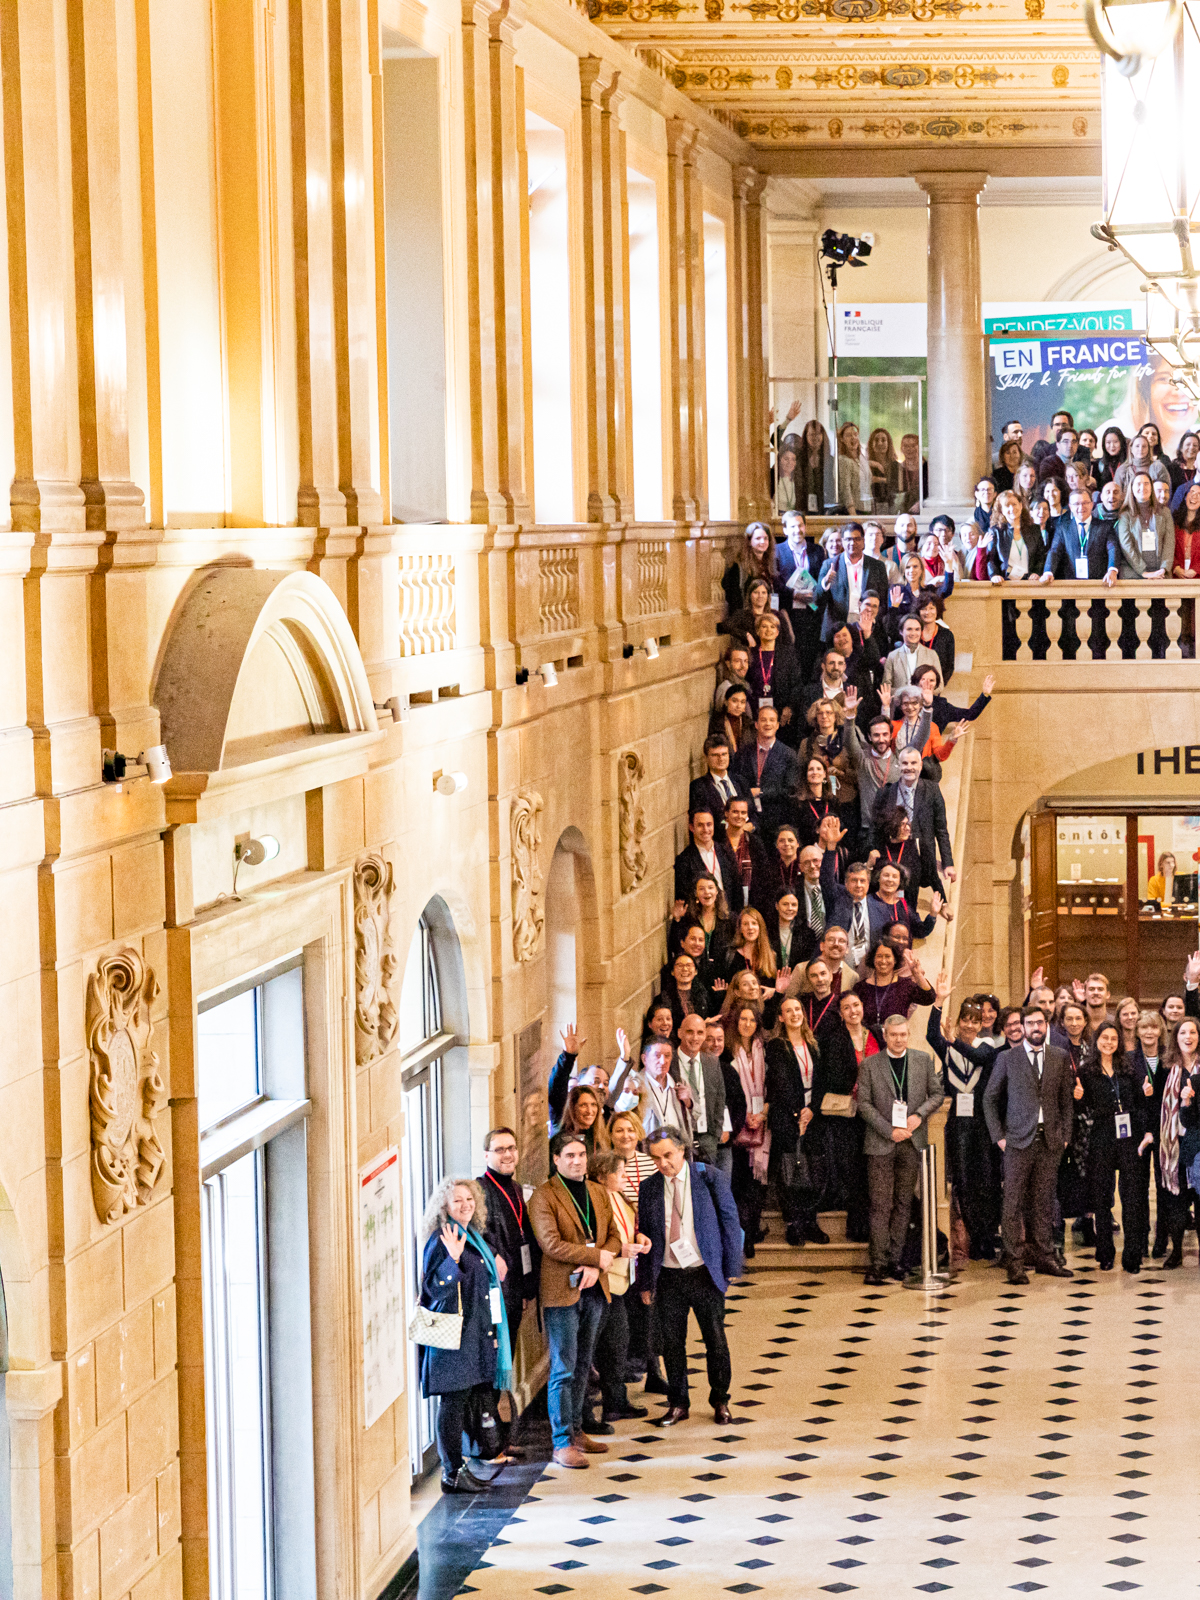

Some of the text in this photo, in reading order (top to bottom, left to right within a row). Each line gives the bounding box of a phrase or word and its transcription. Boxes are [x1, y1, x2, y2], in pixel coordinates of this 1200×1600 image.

[844, 319, 883, 327] RÉPUBLIQUE
[1003, 341, 1142, 368] EN FRANCE
[996, 362, 1156, 391] Skills & Friends for life
